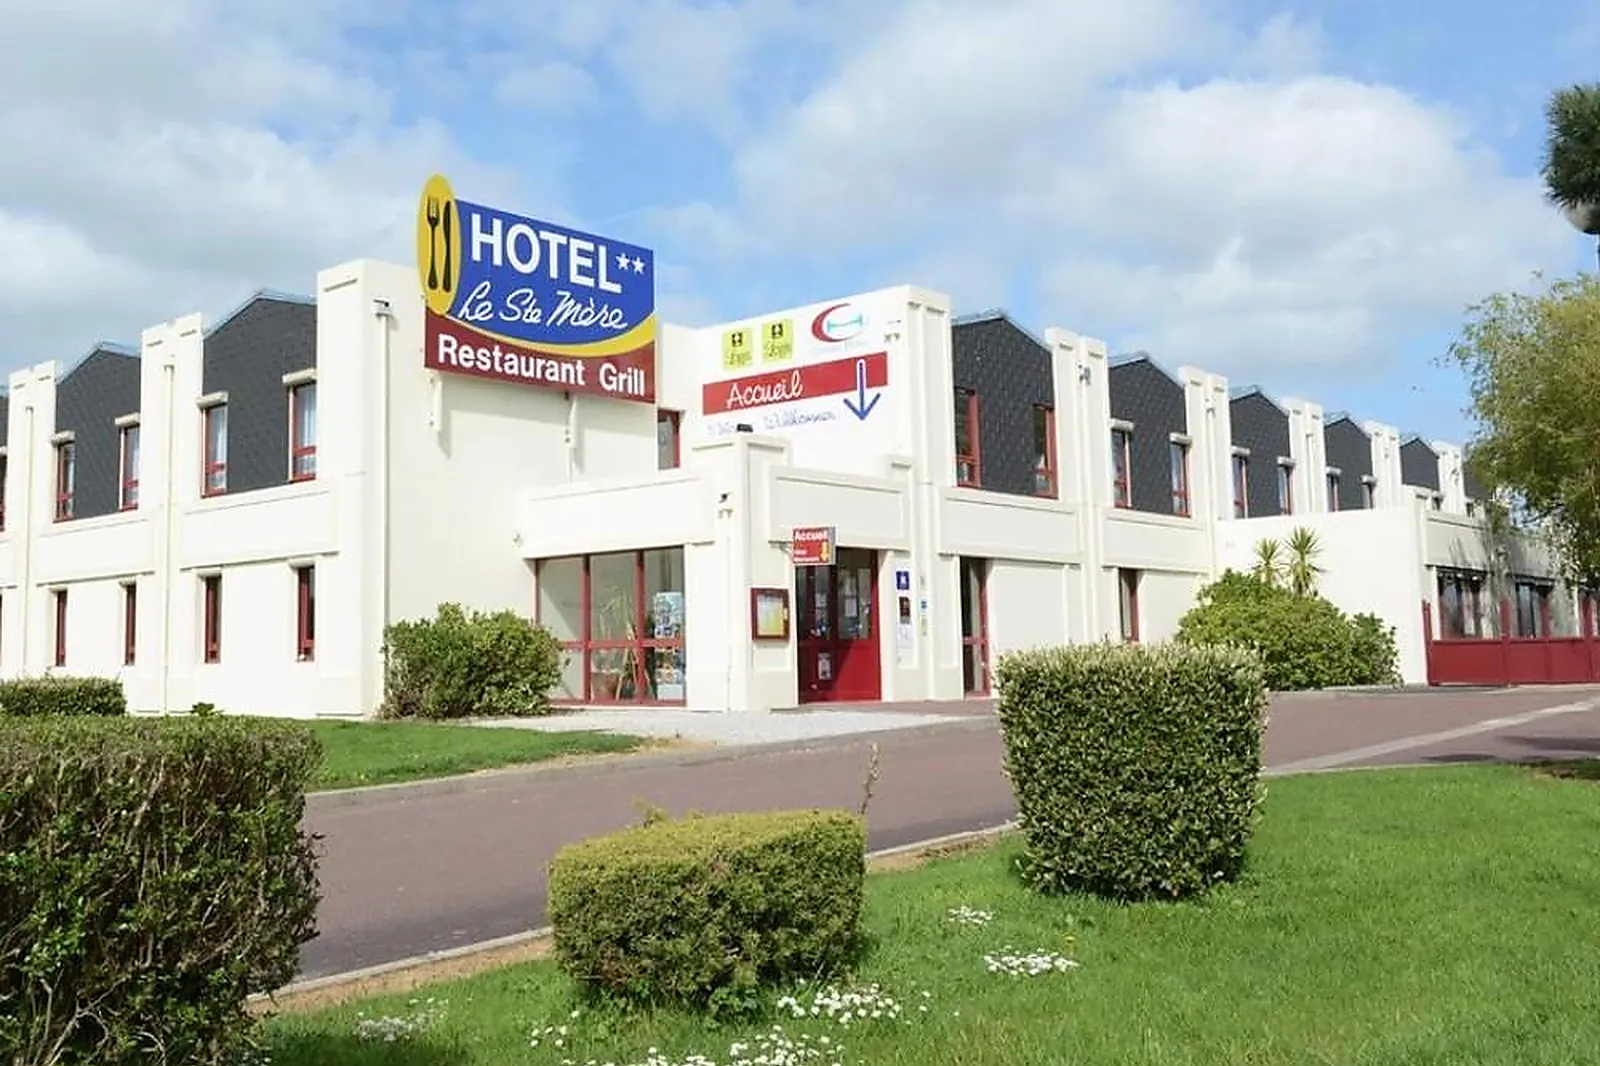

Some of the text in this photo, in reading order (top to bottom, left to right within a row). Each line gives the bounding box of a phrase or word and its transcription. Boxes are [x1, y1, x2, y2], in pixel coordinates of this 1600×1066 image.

[471, 212, 622, 294] HOTEL
[458, 280, 629, 330] Le Ste Mère
[437, 333, 645, 397] Restaurant Grill
[727, 369, 804, 410] Accueil
